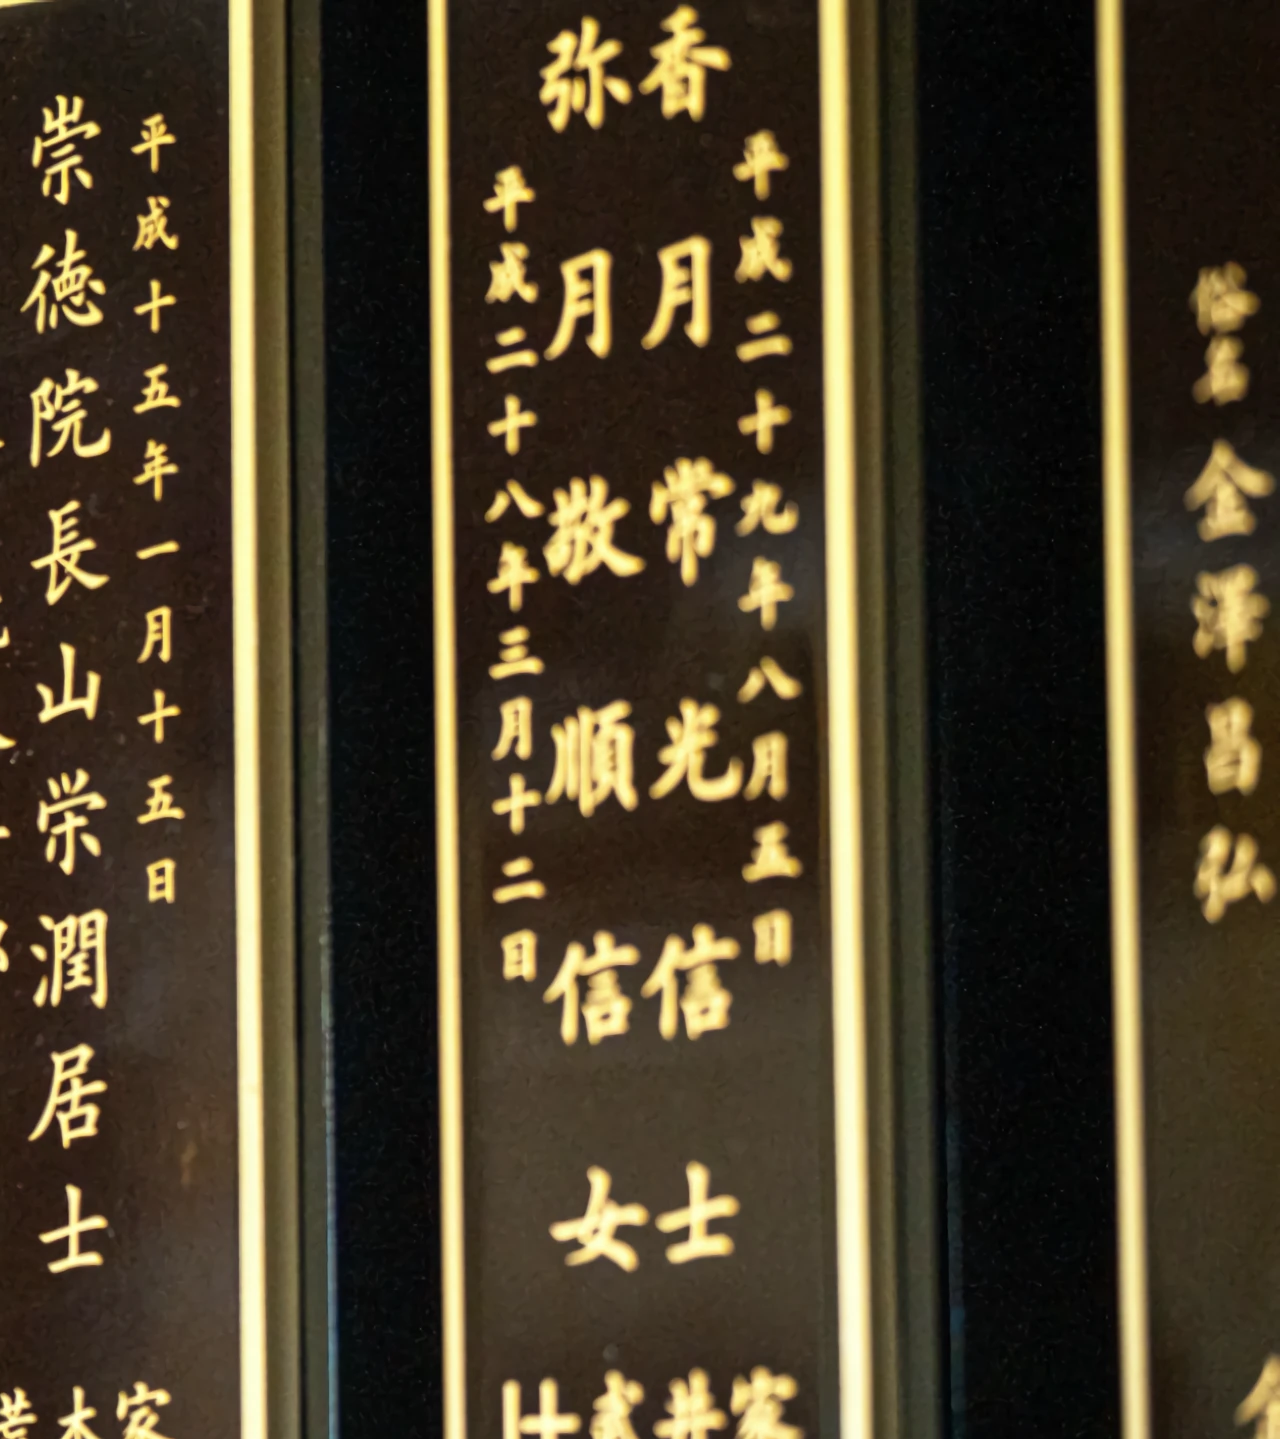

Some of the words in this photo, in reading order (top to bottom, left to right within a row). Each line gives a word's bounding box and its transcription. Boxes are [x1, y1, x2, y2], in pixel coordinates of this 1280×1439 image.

[21, 94, 112, 1275] 崇徳院長山栄潤居士
[130, 113, 186, 904] 平成十五年一月十五日
[483, 165, 545, 982] 平成二十八年三月十二日
[640, 5, 742, 1264] 香月常光信士
[733, 130, 802, 966] 平成二十九年八月五日
